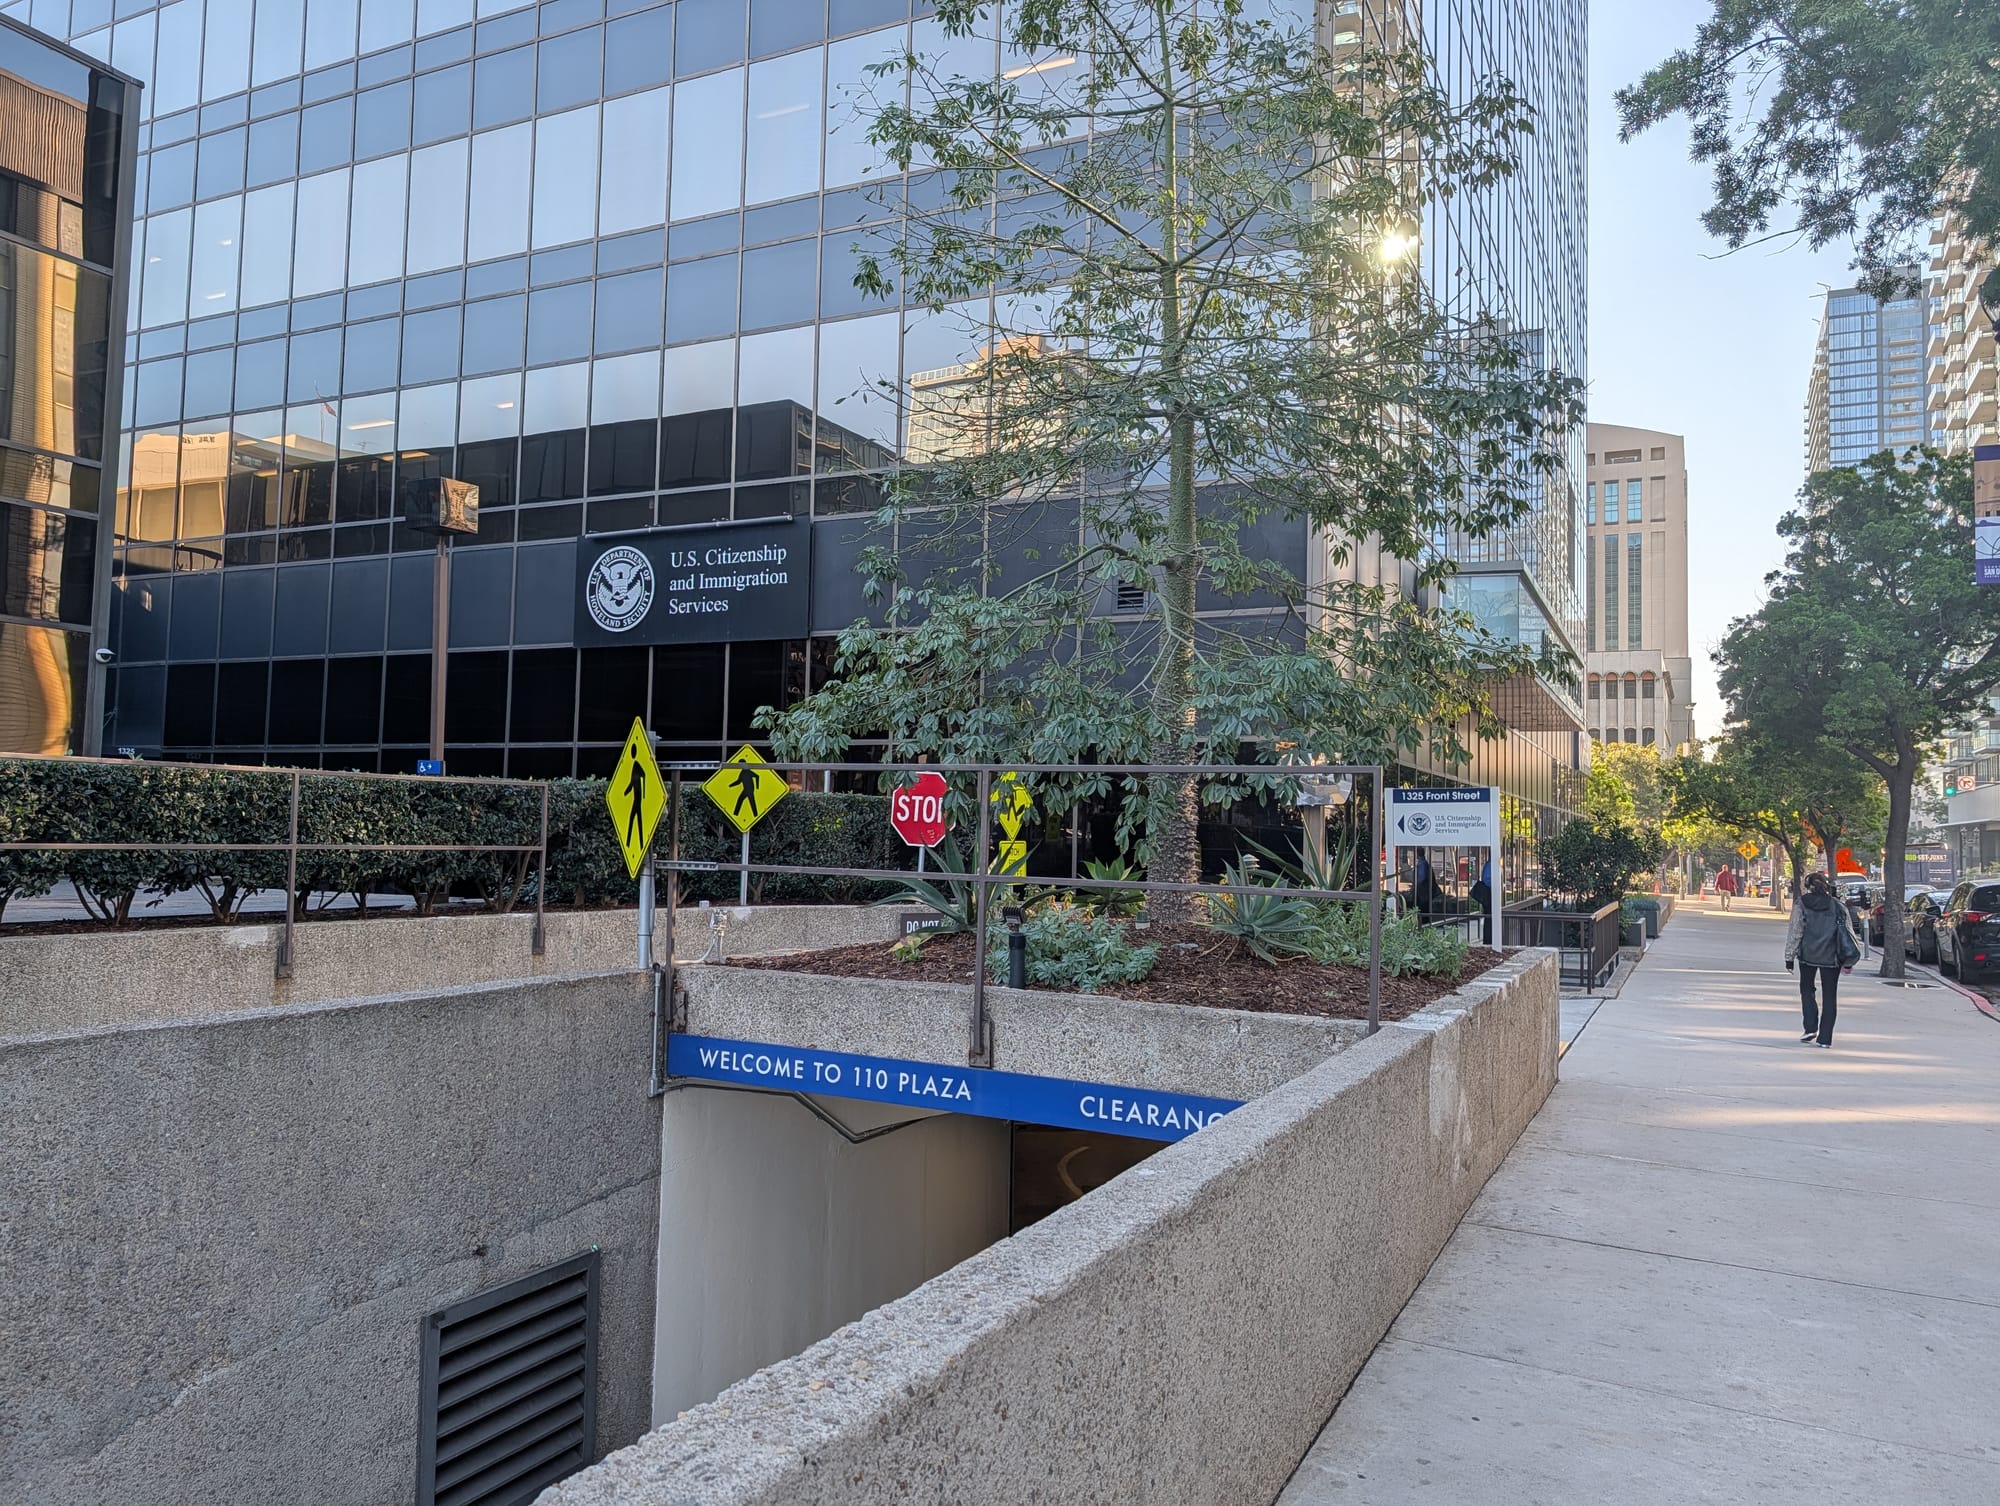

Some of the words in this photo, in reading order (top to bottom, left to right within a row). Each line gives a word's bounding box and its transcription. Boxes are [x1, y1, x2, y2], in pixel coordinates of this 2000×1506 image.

[590, 570, 600, 584] U.S.
[602, 550, 647, 569] DEPARTMENT
[644, 569, 650, 581] OF
[671, 551, 701, 568] U.S.
[706, 544, 787, 564] Citizenship
[670, 574, 694, 591] and
[699, 568, 788, 591] Immigration
[590, 594, 620, 628] HOMELAND
[623, 590, 650, 626] SECURITY
[669, 596, 728, 614] Services
[1402, 792, 1424, 800] 1325
[1426, 792, 1450, 800] Front
[1452, 791, 1480, 800] Street
[1446, 814, 1482, 822] Citizenship
[700, 1048, 804, 1079] WELCOME
[814, 1062, 842, 1084] TO
[854, 1066, 888, 1090] 110
[898, 1072, 972, 1100] PLAZA
